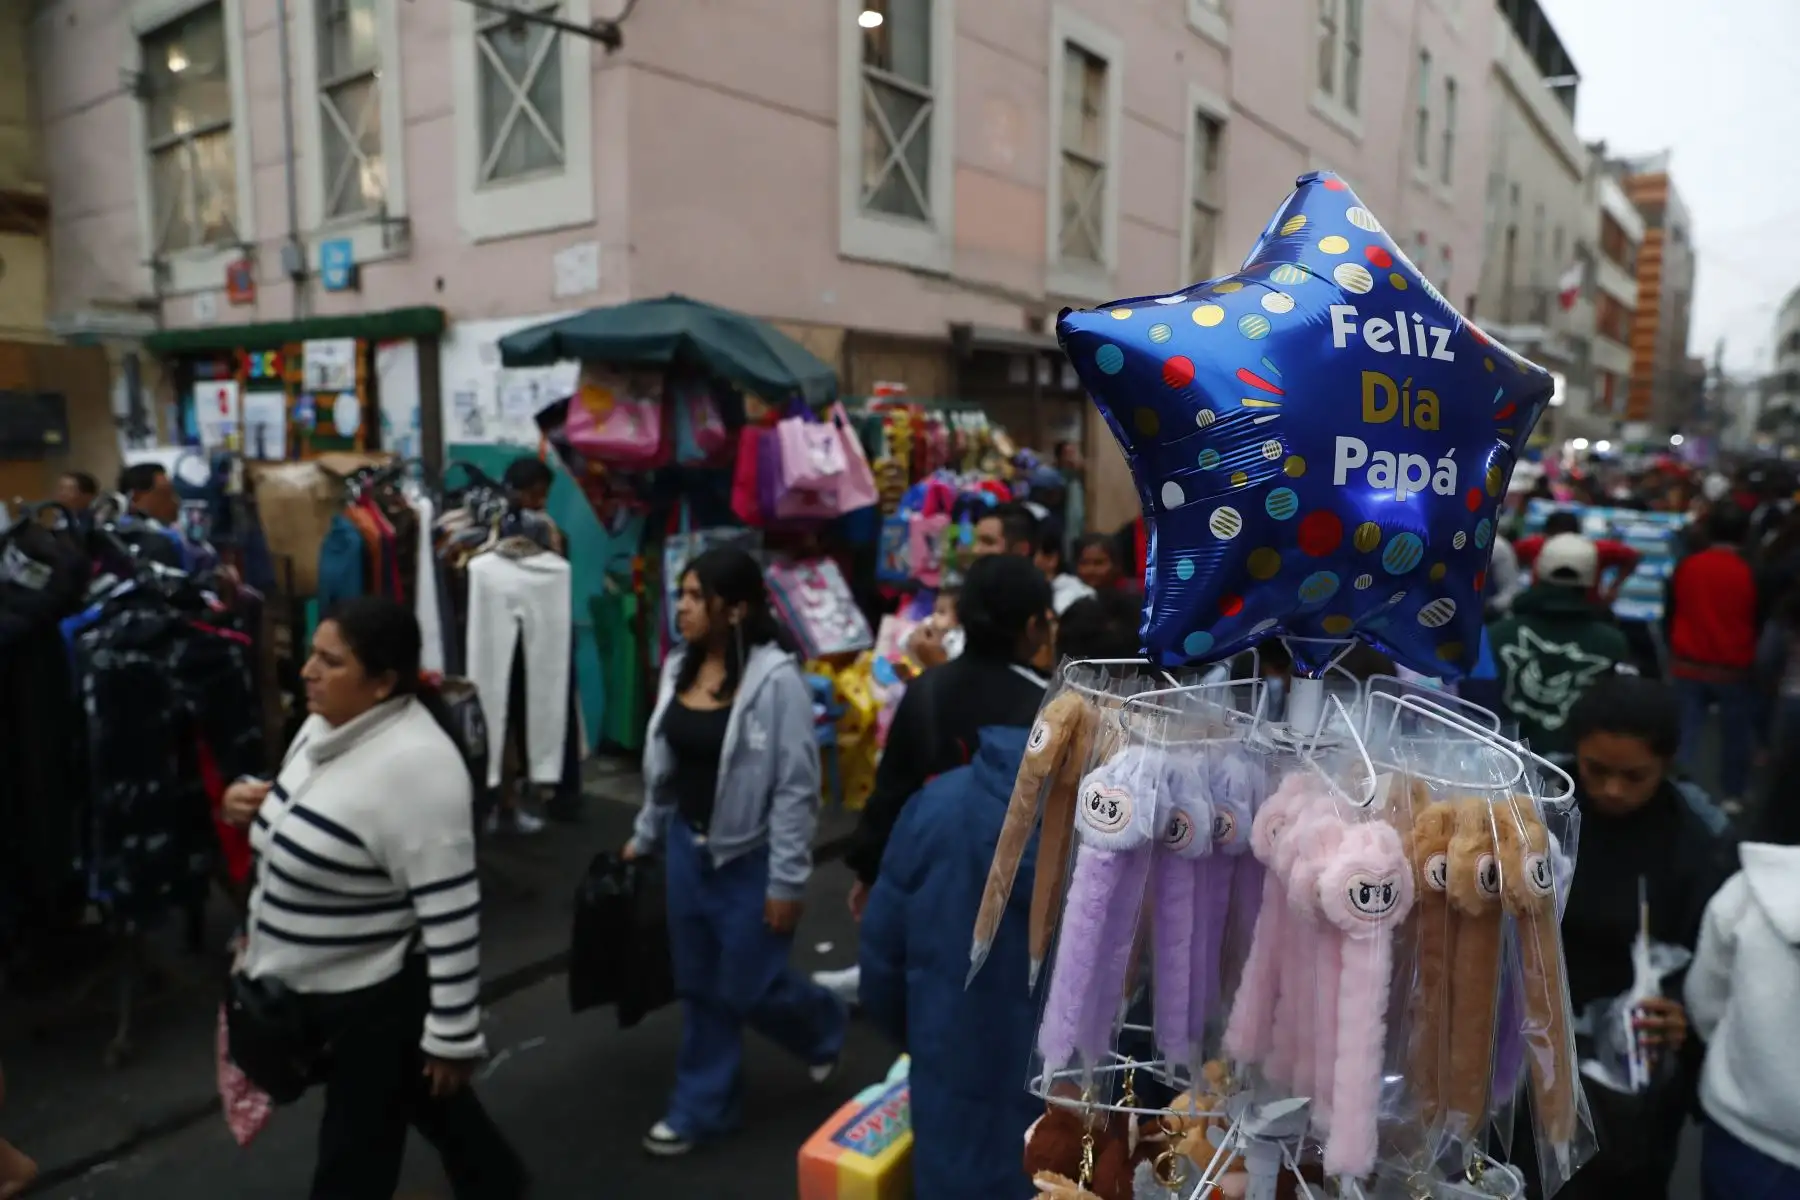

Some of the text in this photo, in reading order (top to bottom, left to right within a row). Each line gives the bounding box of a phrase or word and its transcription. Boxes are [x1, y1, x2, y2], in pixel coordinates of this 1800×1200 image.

[1329, 304, 1455, 362] Feliz
[1361, 371, 1440, 430] Día
[1333, 436, 1458, 502] Papá
